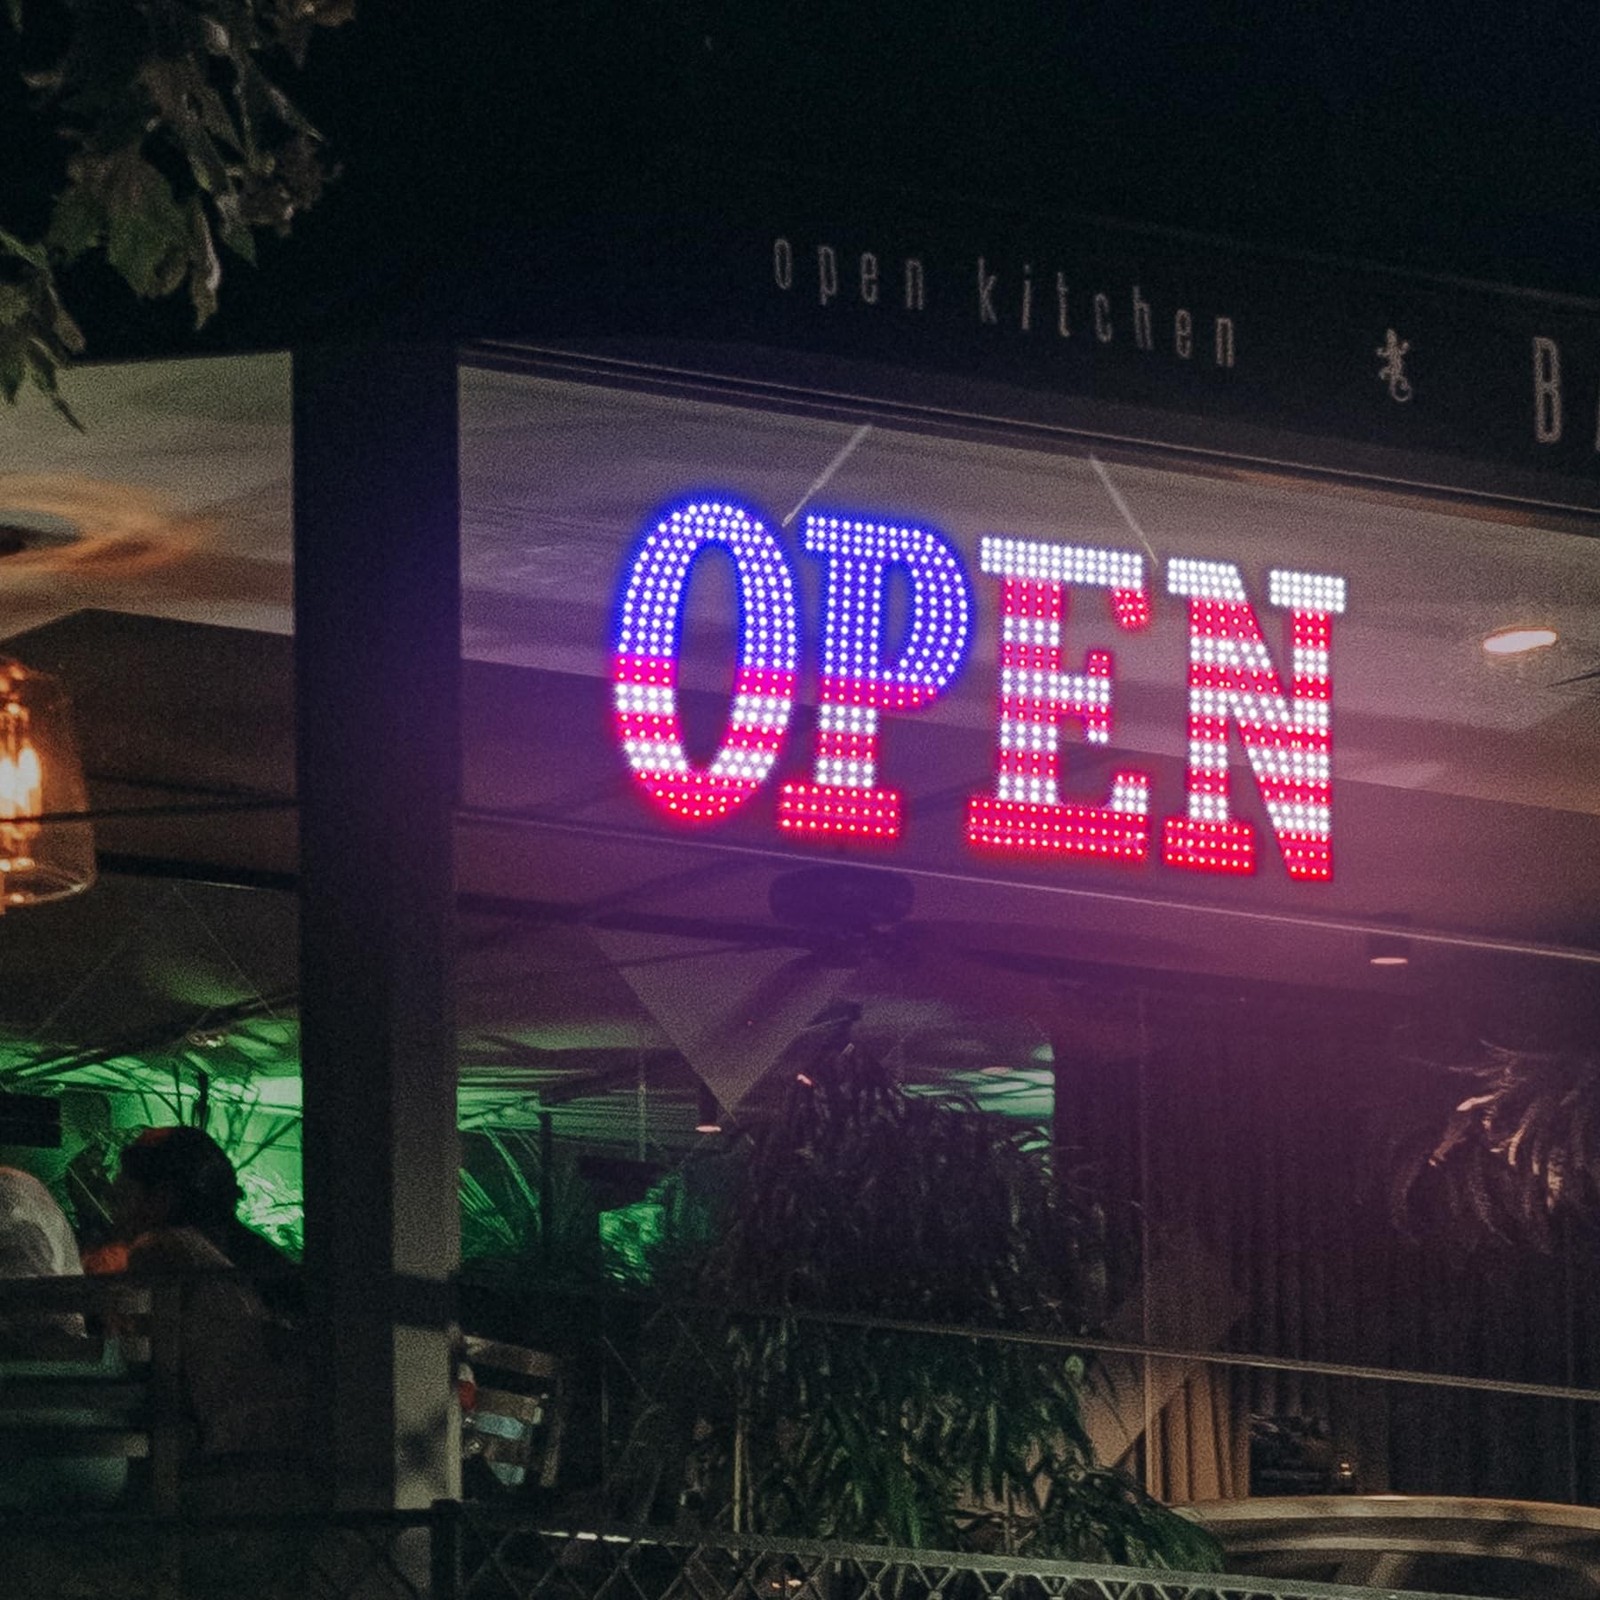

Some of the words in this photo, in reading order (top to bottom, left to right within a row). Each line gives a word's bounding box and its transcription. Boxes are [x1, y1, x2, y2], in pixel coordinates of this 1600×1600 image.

[774, 237, 925, 310] open
[977, 256, 1235, 367] kitchen
[612, 500, 1346, 881] OPEN
